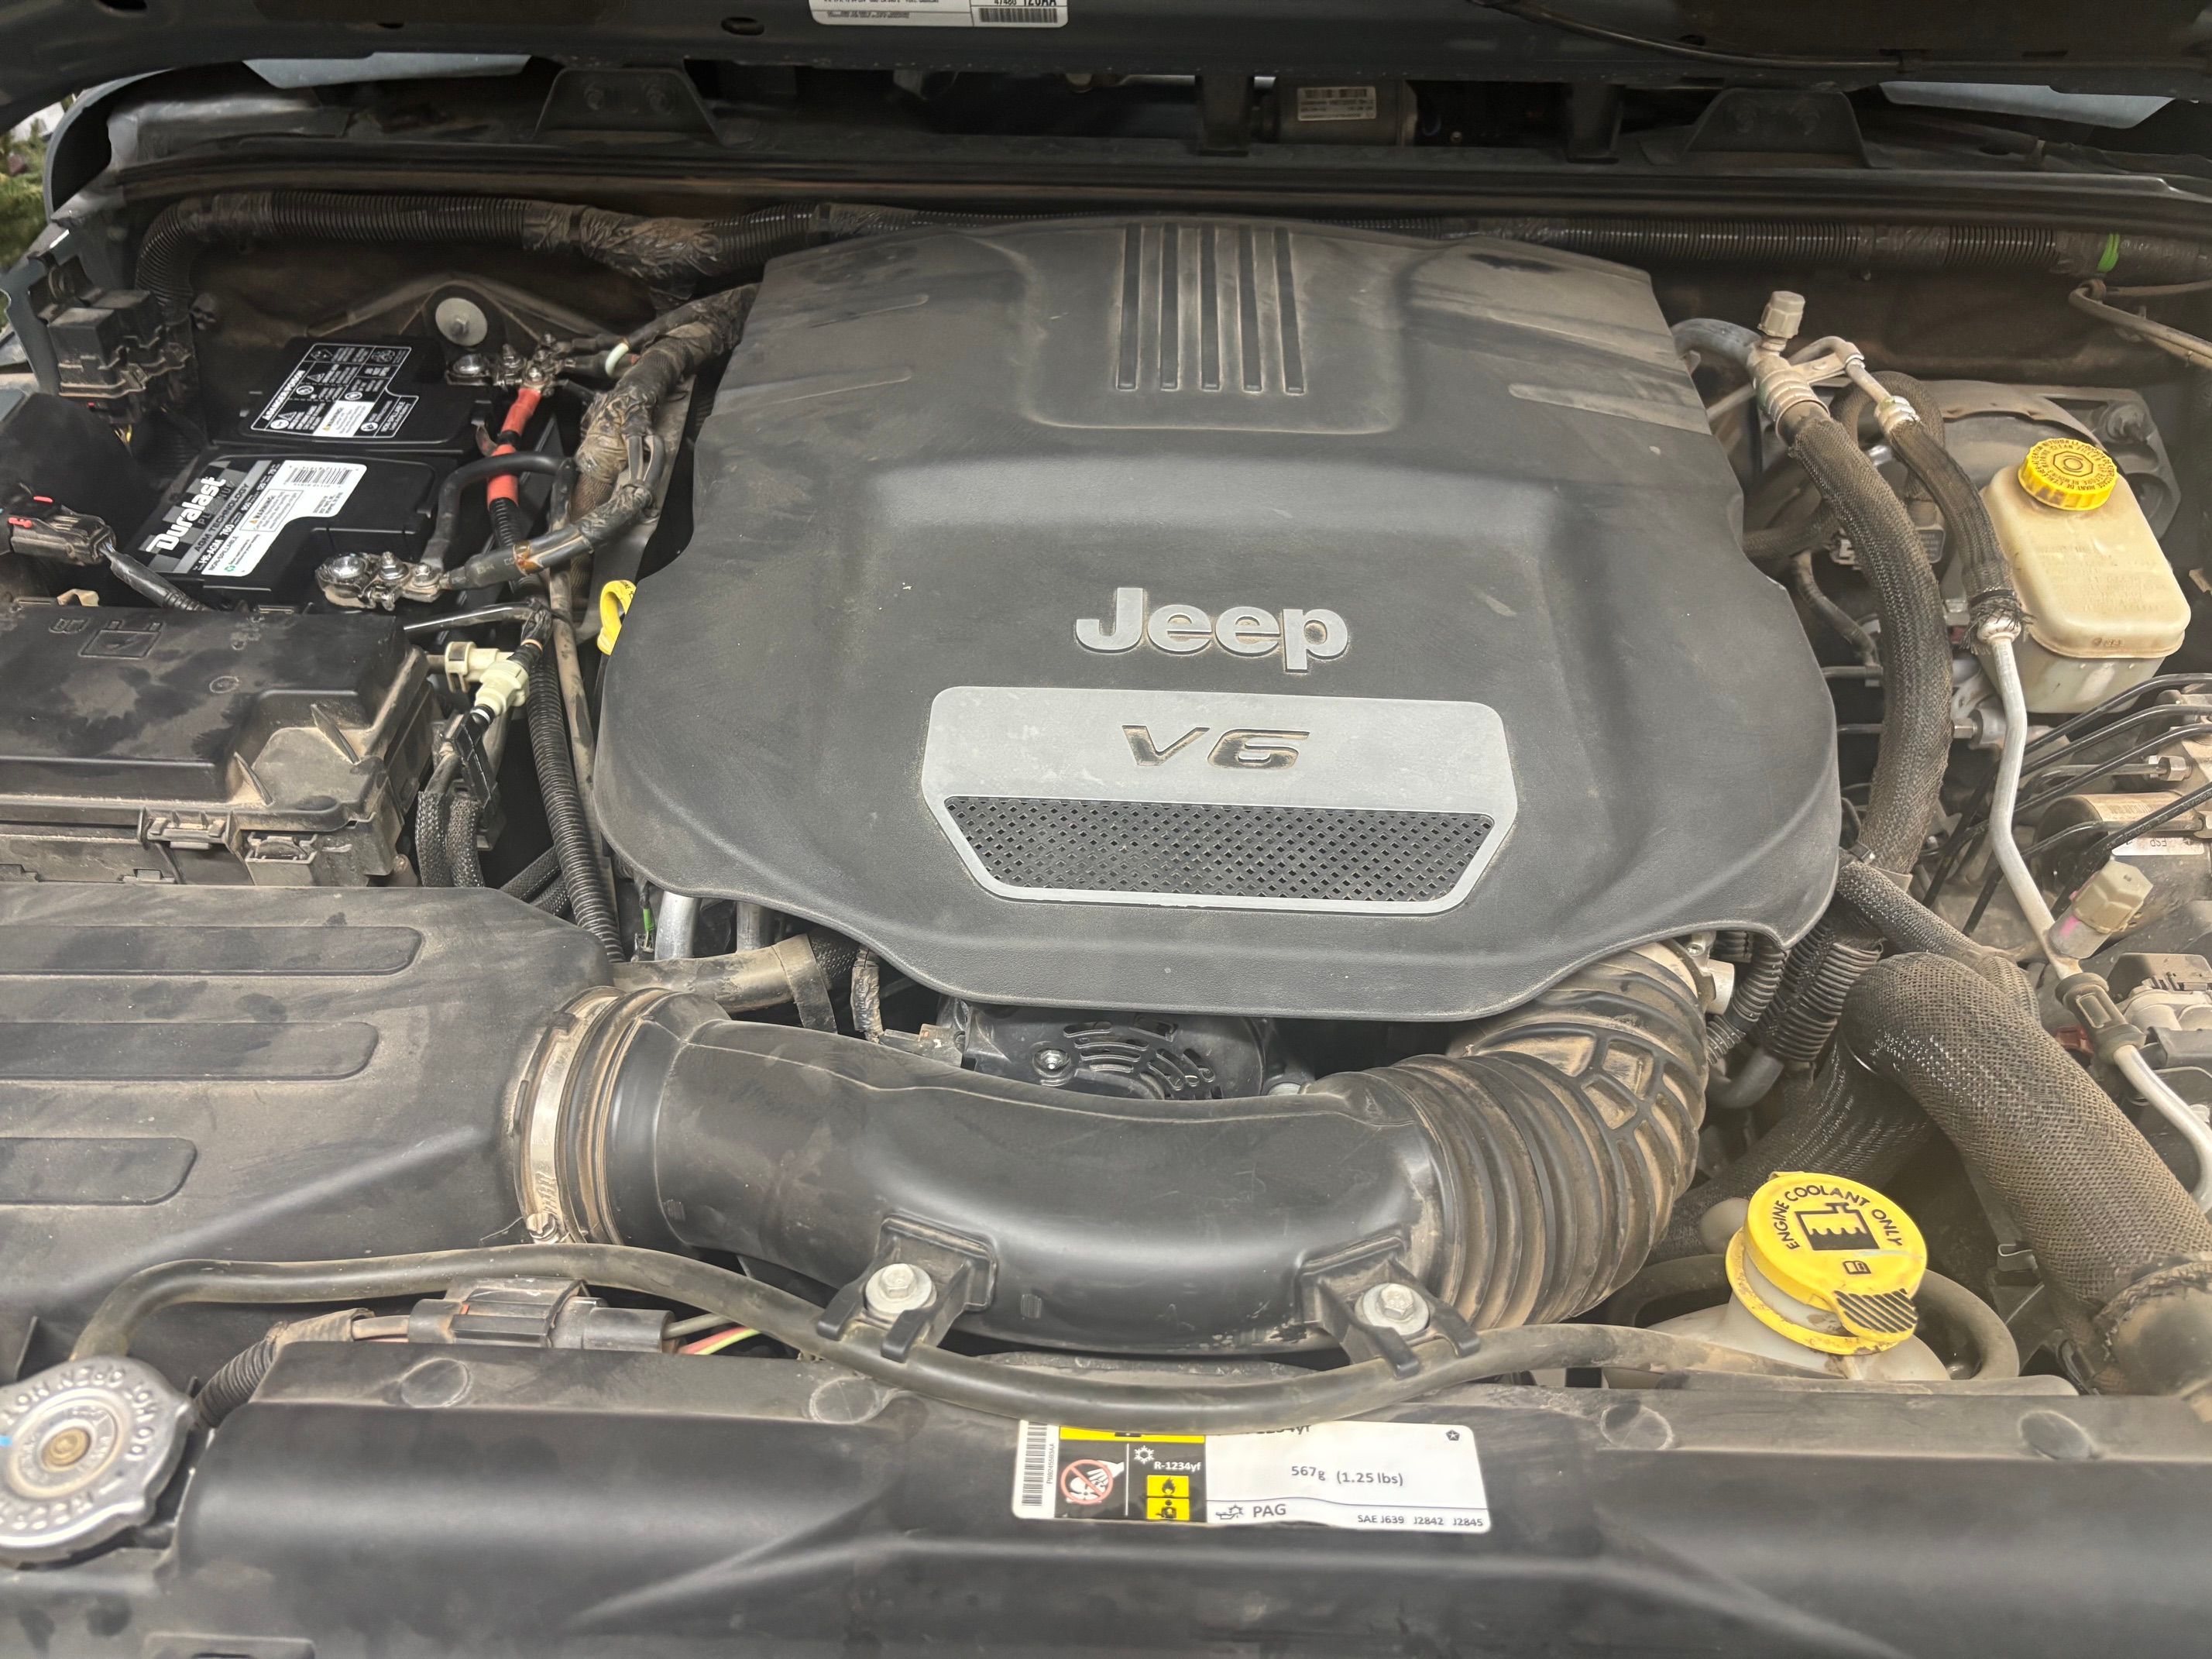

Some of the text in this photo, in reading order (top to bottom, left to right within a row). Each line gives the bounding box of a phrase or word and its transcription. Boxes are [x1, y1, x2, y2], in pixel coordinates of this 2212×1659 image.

[145, 476, 226, 553] Duralast
[194, 532, 211, 552] AGM
[208, 483, 250, 533] TECHNOLOGY
[1075, 587, 1348, 673] Jeep
[1121, 724, 1310, 769] V6
[1772, 1184, 1903, 1250] ENGINE COOLANT ONLY
[1153, 1461, 1202, 1472] R-1234yf
[1291, 1465, 1403, 1487] 567g (1.25 lbs)
[1252, 1503, 1287, 1518] PAG
[1358, 1514, 1484, 1527] SAE J639 J2842 J2845
